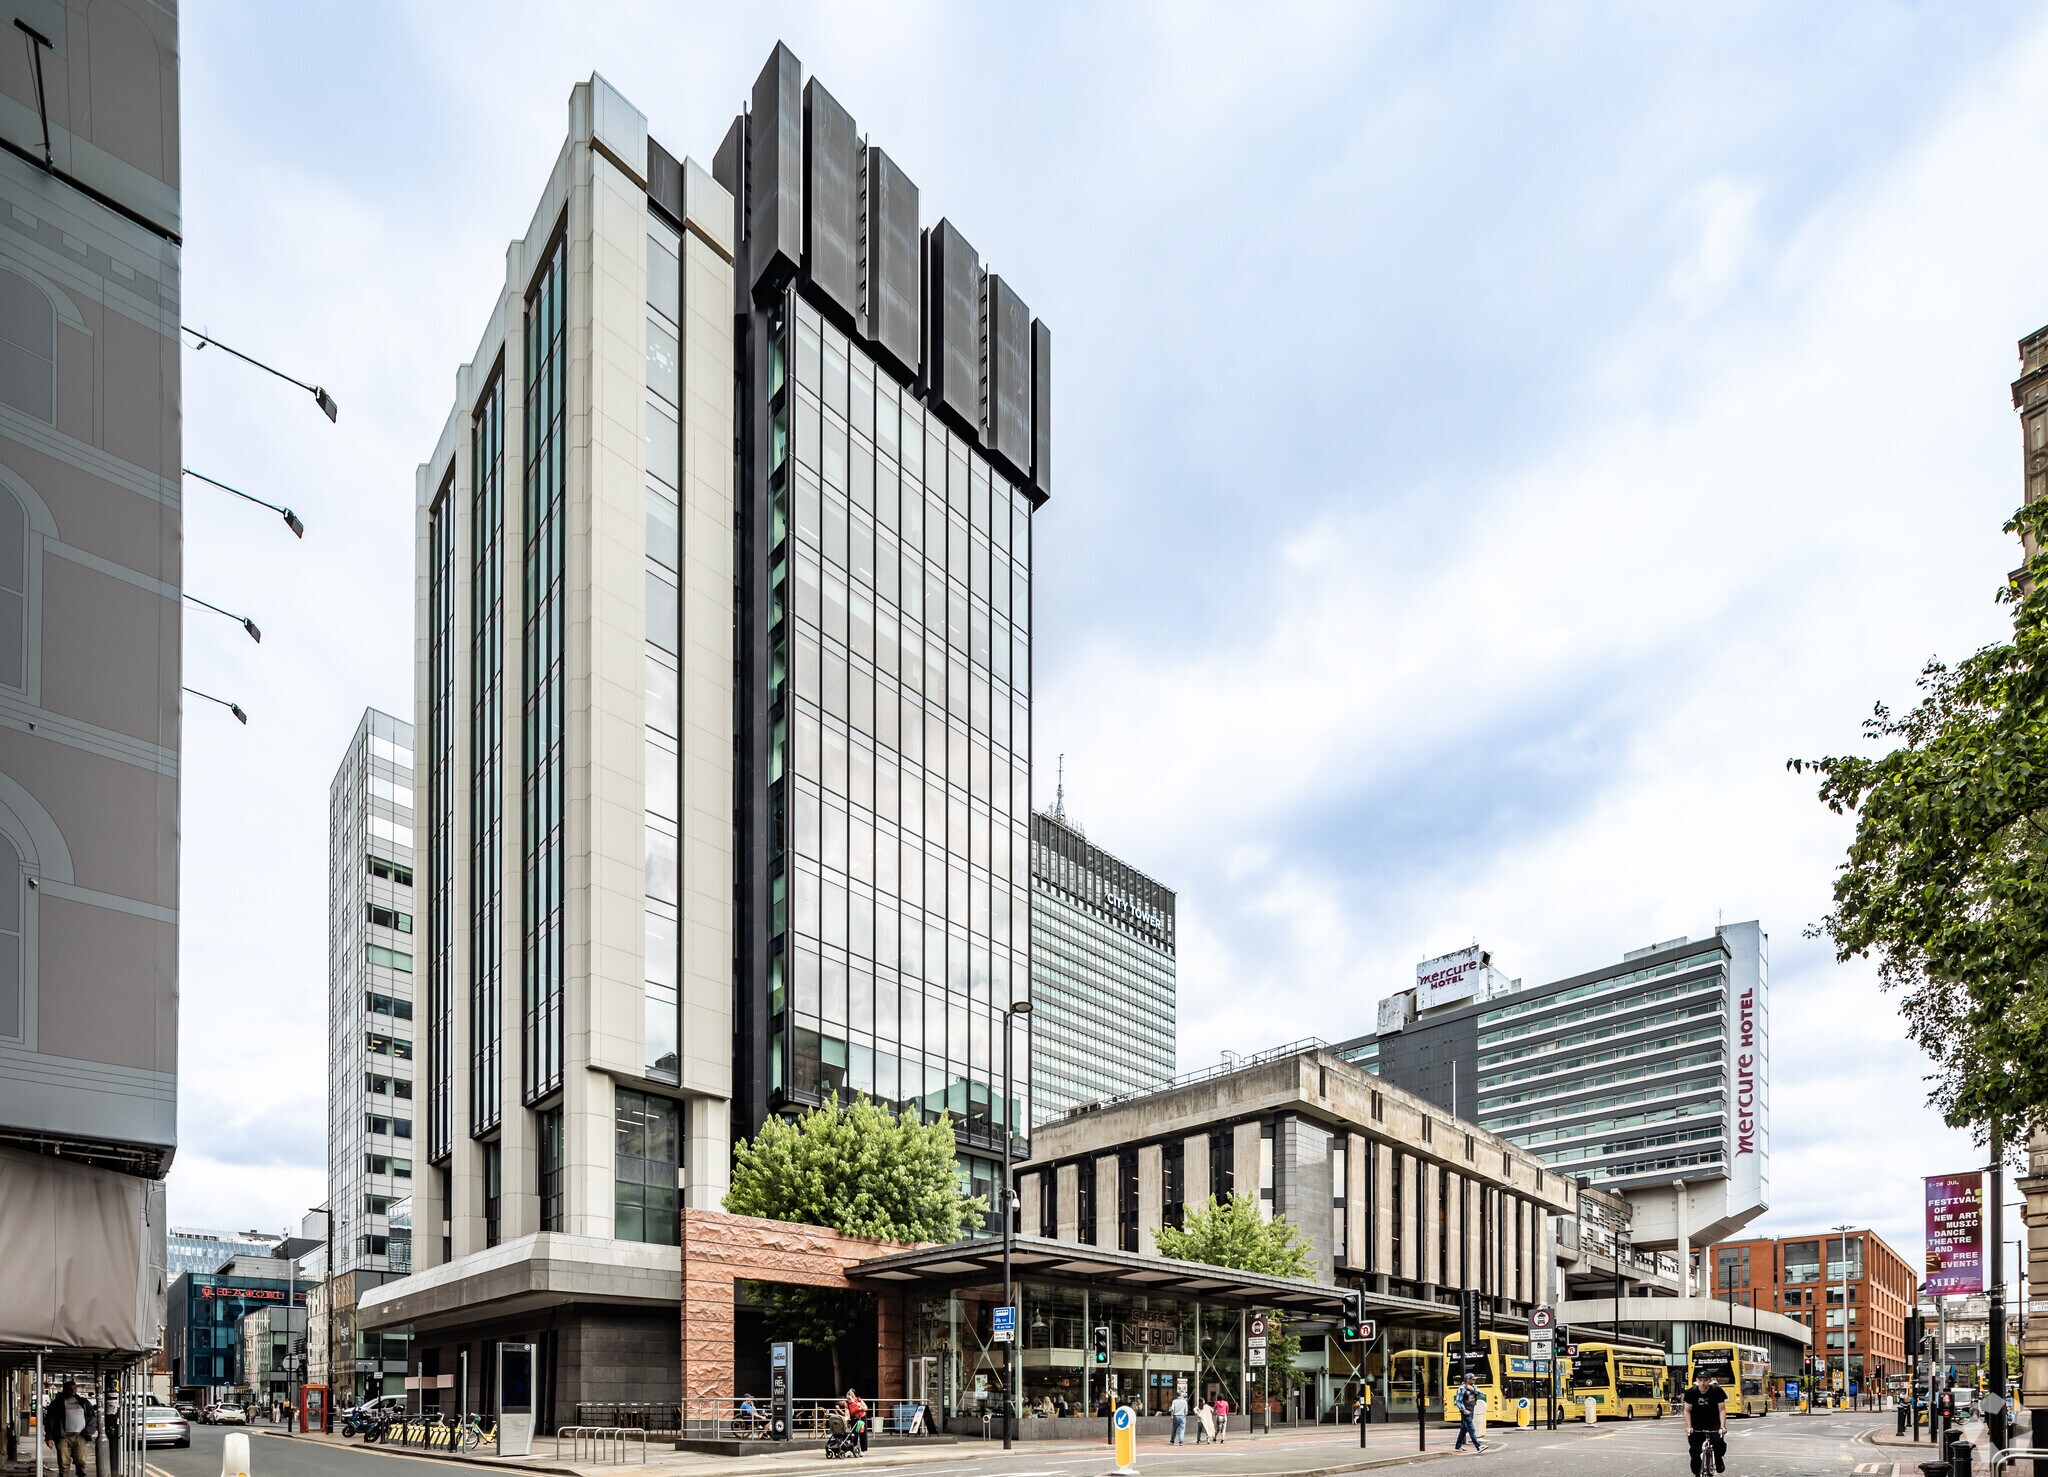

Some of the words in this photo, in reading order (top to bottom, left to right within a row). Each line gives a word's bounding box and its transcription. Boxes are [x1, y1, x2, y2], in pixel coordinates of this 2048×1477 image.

[1107, 892, 1128, 911] CITY
[1131, 905, 1161, 930] TOWER
[1430, 974, 1464, 990] HOTEL
[1740, 987, 1754, 1047] HOTEL
[1928, 1196, 1978, 1207] FESTIVAL
[1934, 1214, 1954, 1222] NEW
[1959, 1211, 1978, 1220] ART
[1946, 1219, 1978, 1229] MUSIC
[1934, 1228, 1966, 1238] DANCE
[1928, 1236, 1972, 1246] THEATRE
[1953, 1251, 1978, 1260] FREE
[1940, 1259, 1979, 1269] EVENTS
[216, 1288, 242, 1297] BEA
[1122, 1323, 1178, 1347] NERO
